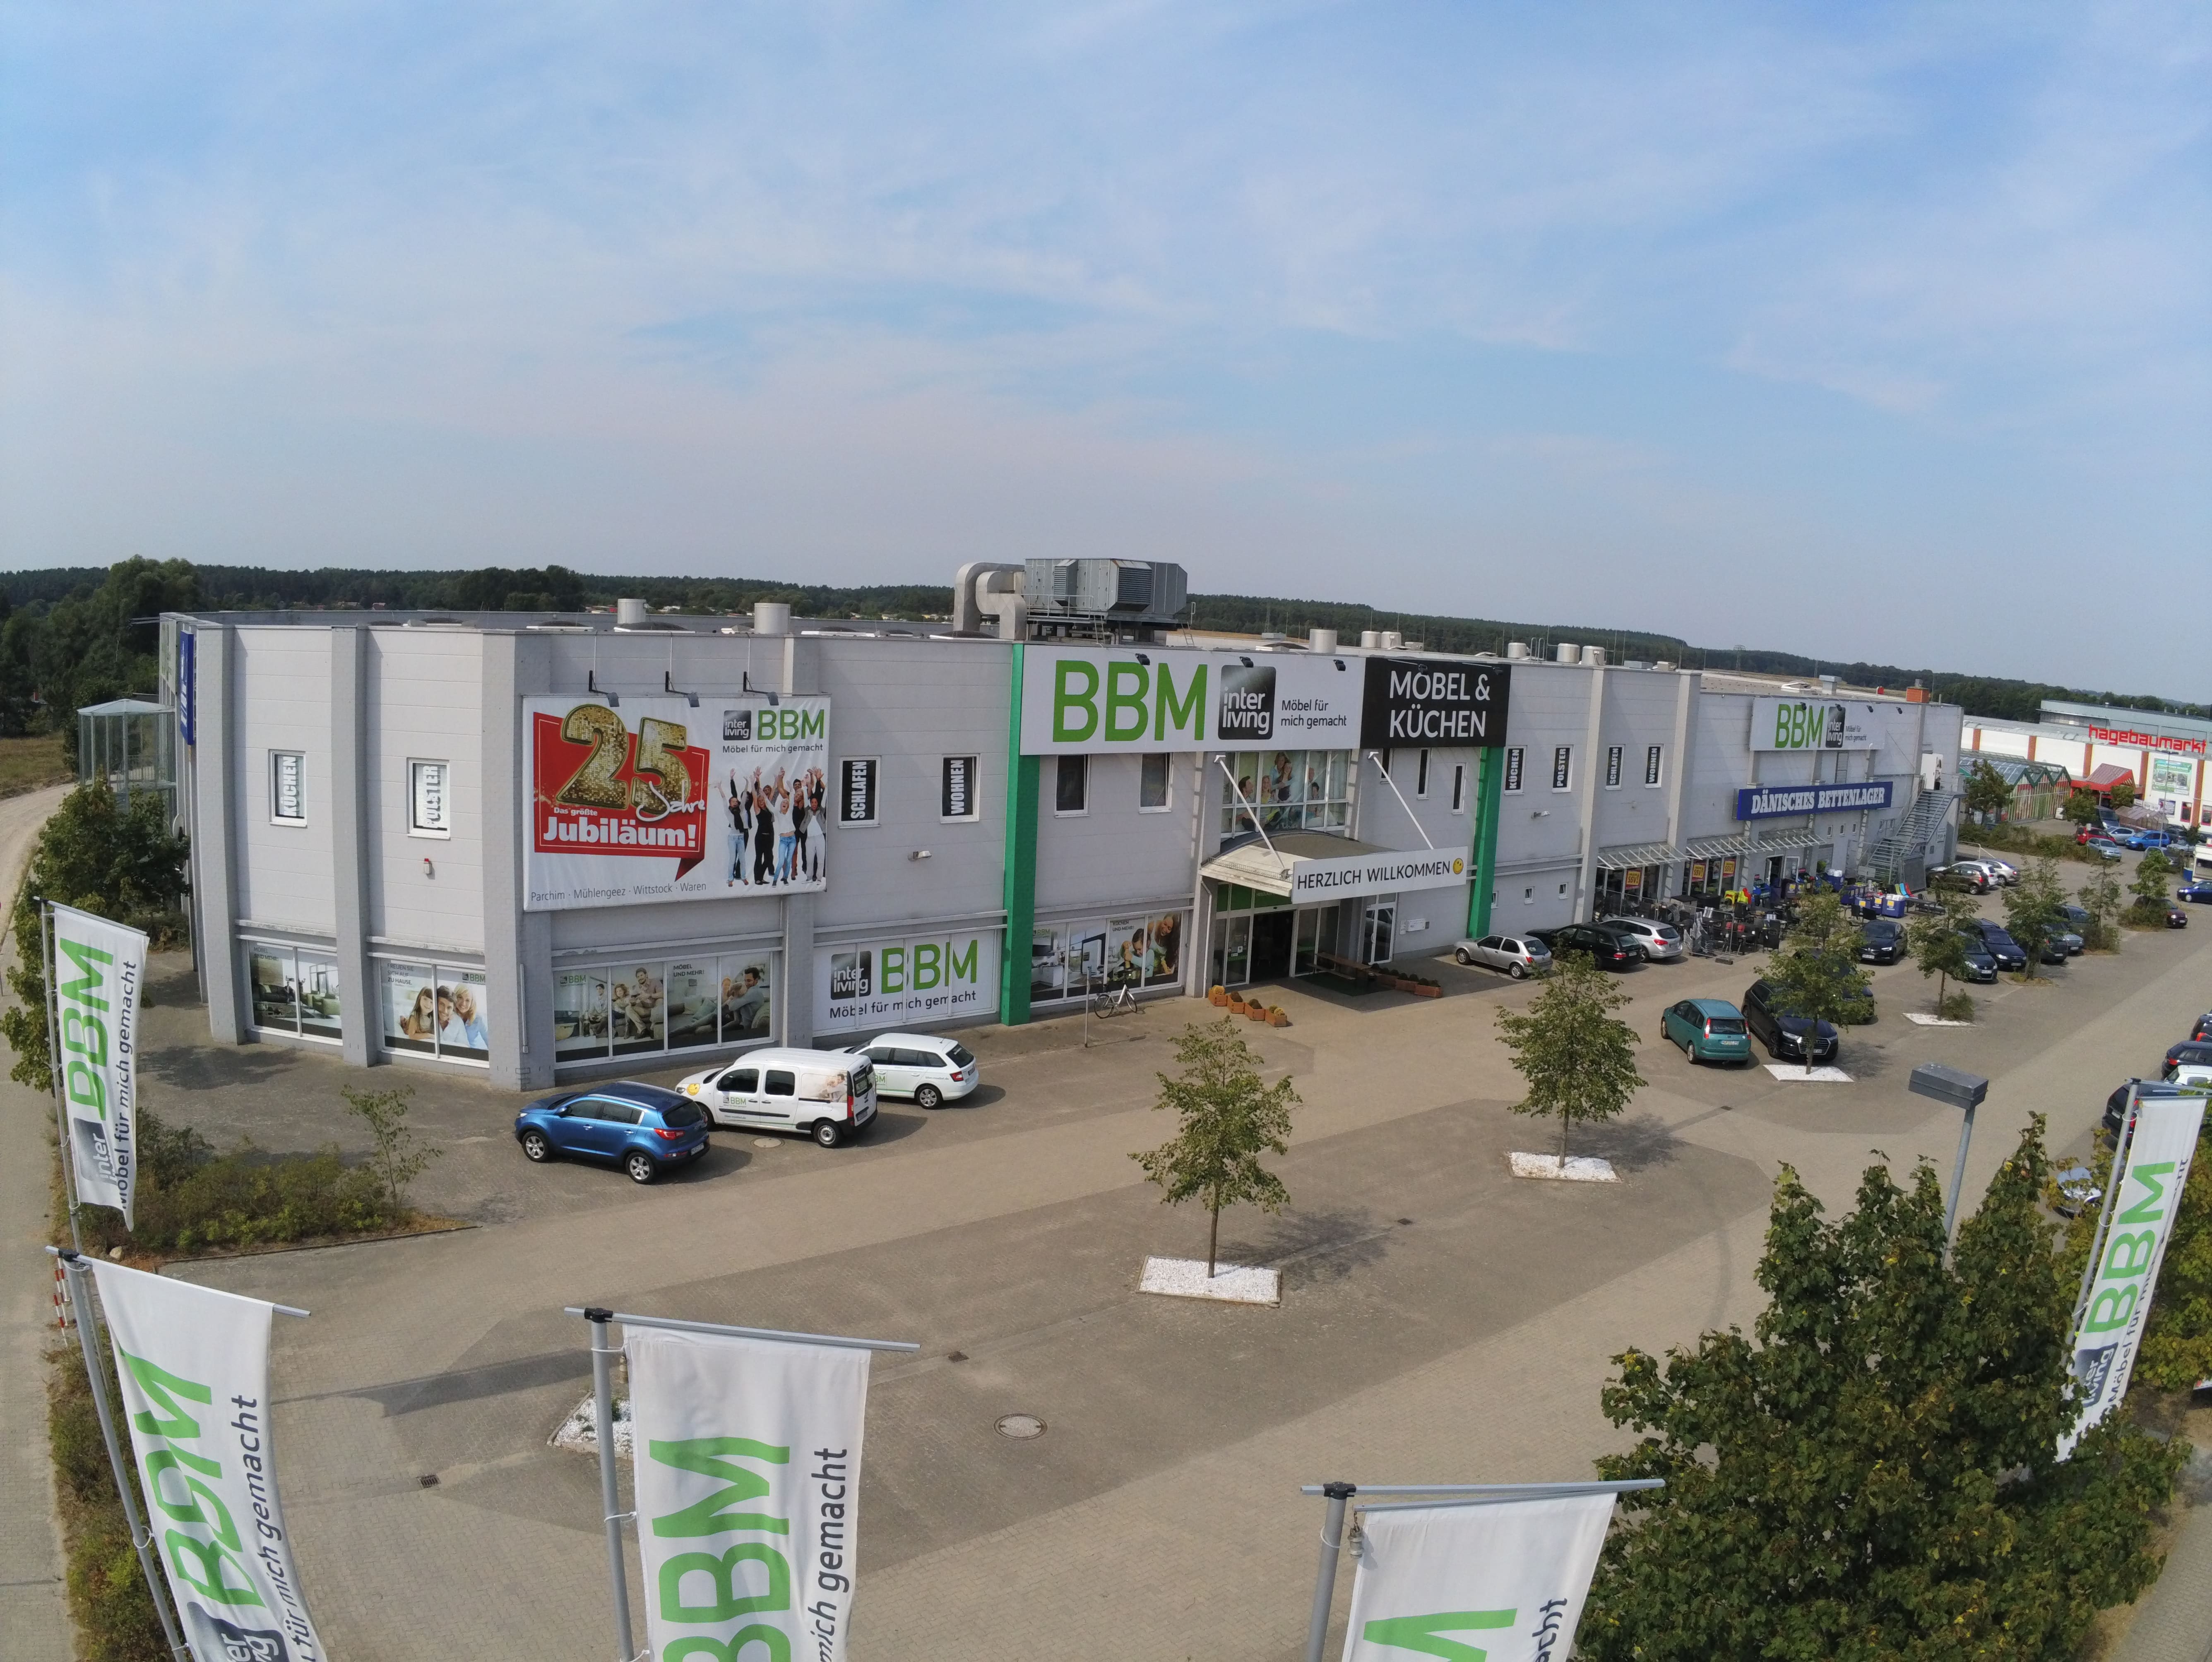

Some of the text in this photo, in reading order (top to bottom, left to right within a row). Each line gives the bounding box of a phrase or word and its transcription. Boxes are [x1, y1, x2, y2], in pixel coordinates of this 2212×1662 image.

[1053, 660, 1207, 742] BBM
[1224, 687, 1265, 711] inter
[1475, 674, 1490, 701] &
[1282, 699, 1328, 711] Möbel für
[725, 719, 745, 729] inter
[725, 728, 749, 739] living
[758, 710, 825, 740] BBM
[1222, 709, 1270, 735] living
[1281, 714, 1347, 729] mich gemacht
[1390, 704, 1486, 737] KÜCHEN
[1775, 704, 1824, 748] BBM
[723, 743, 823, 754] Möbel für mich gemacht
[1827, 728, 1842, 745] living
[1854, 734, 1867, 742] gemacht
[2089, 724, 2206, 754] hagebaumarkt
[557, 704, 690, 816] 25
[1508, 749, 1520, 790] KÜCHEN
[1556, 748, 1567, 787] POLSTER
[1609, 748, 1619, 785] SCHLAFEN
[1649, 747, 1658, 783] WOHNEN
[281, 757, 297, 816] KÜCHEN
[636, 781, 706, 822] Jahre
[850, 761, 867, 819] SCHLAFEN
[951, 760, 964, 814] WOHNEN
[1751, 787, 1885, 814] DÄNISCHES BETTENLAGER
[571, 808, 598, 818] größte
[543, 817, 696, 847] Jubiläum!
[1298, 860, 1450, 890] HERZLICH WILLKOMMEN
[531, 882, 706, 902] Parchim Mühlengeez Wittstock Waren
[469, 974, 486, 983] BBM
[568, 975, 587, 984] BBM
[834, 967, 861, 980] inter
[881, 939, 978, 994] BBM
[833, 978, 868, 996] living
[119, 960, 137, 1056] gemacht
[830, 991, 976, 1019] Möbel für mich gemacht
[117, 1058, 129, 1108] mich
[731, 1097, 746, 1105] BBM
[114, 1112, 129, 1142] für
[2084, 1161, 2176, 1333] BBM
[2108, 1342, 2133, 1403] Möbel
[231, 1394, 282, 1542] gemacht
[811, 1447, 849, 1593] gemacht
[258, 1547, 298, 1607] mich
[284, 1609, 312, 1647] für
